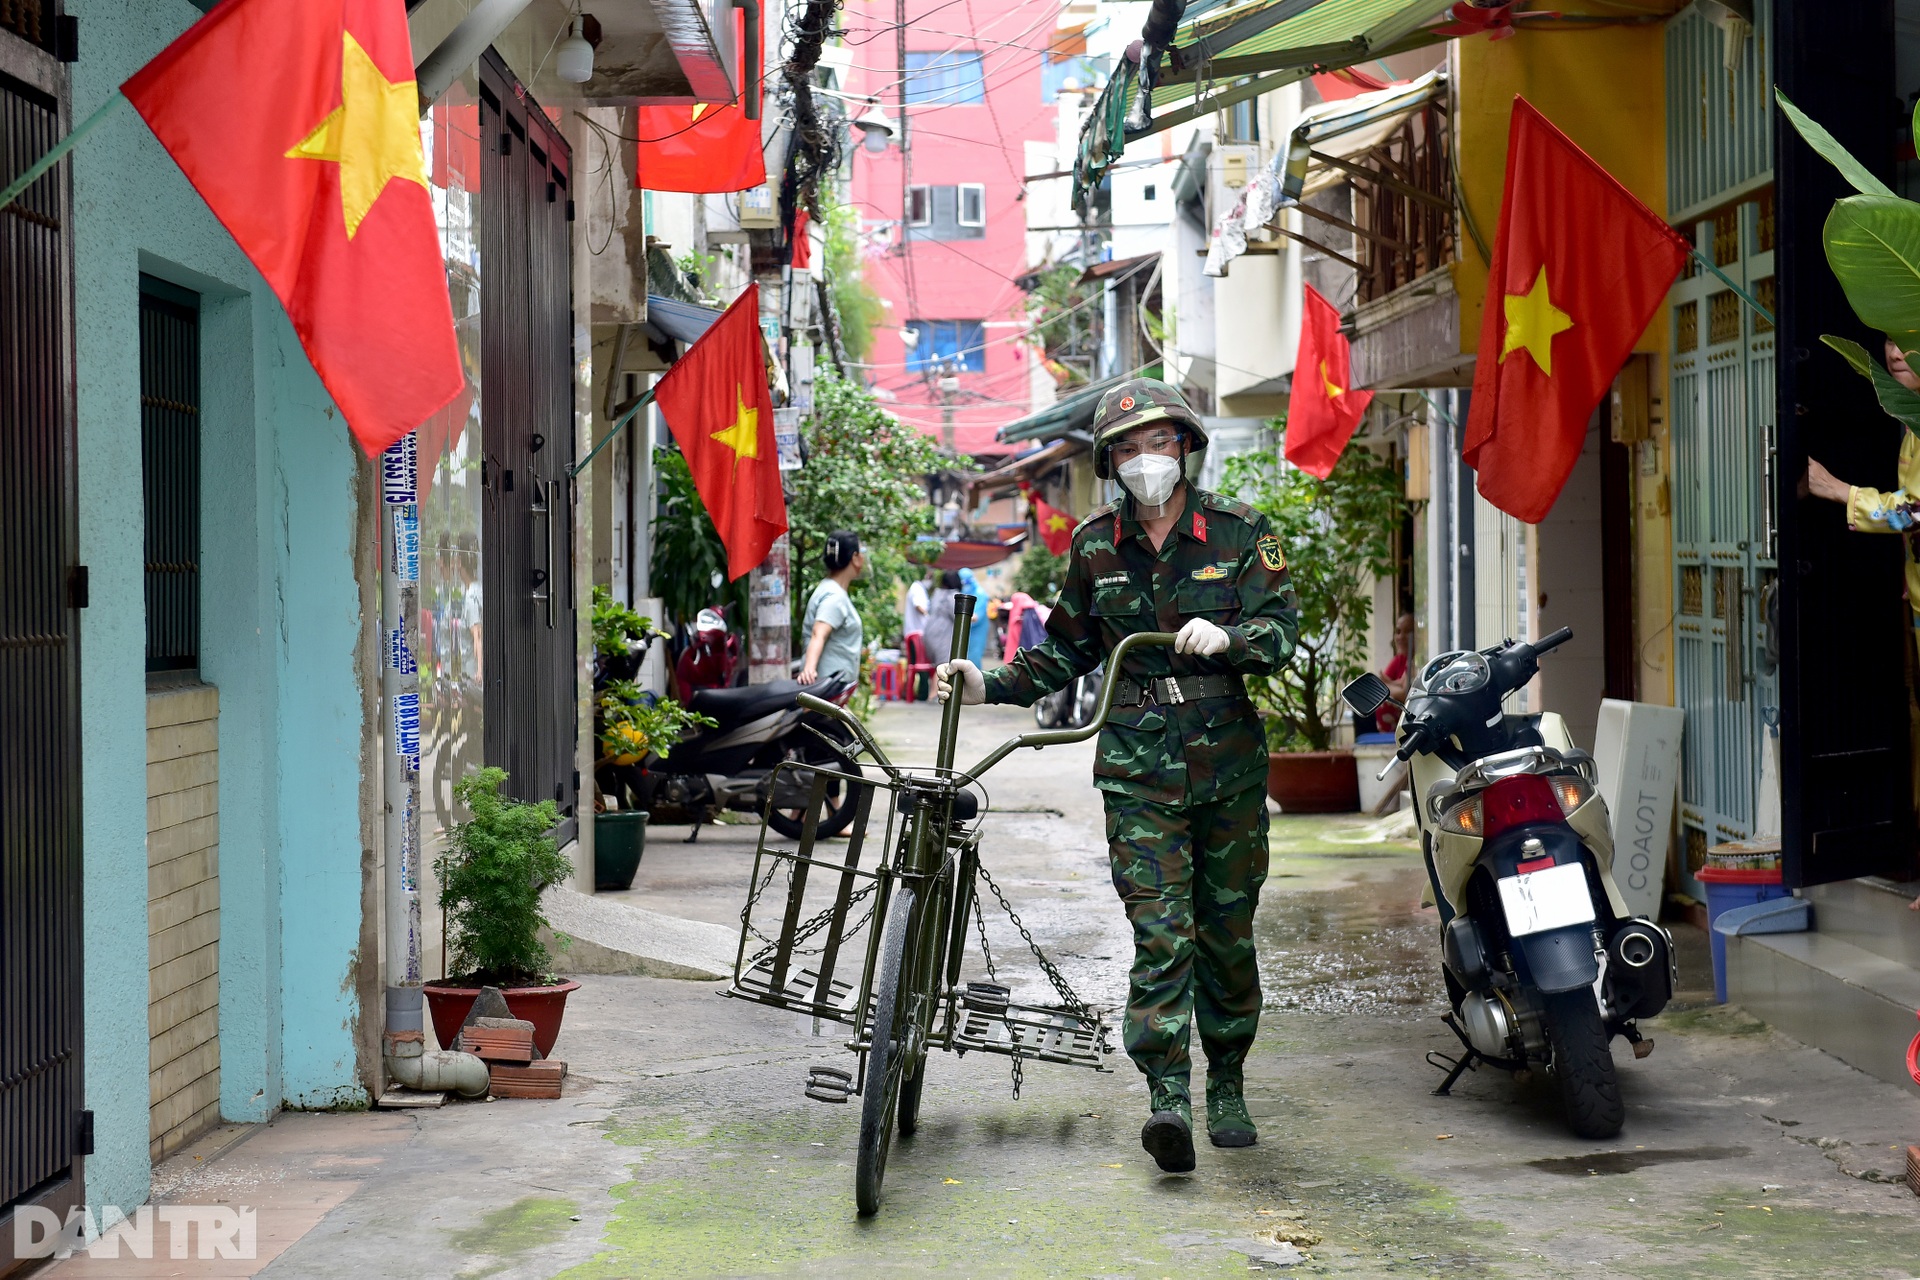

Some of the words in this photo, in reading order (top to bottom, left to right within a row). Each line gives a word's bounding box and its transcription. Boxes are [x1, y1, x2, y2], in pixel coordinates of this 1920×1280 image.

[399, 693, 419, 706] 08
[399, 707, 419, 719] 18
[400, 719, 419, 731] 18
[401, 731, 420, 754] 0977
[1628, 790, 1657, 890] COAST
